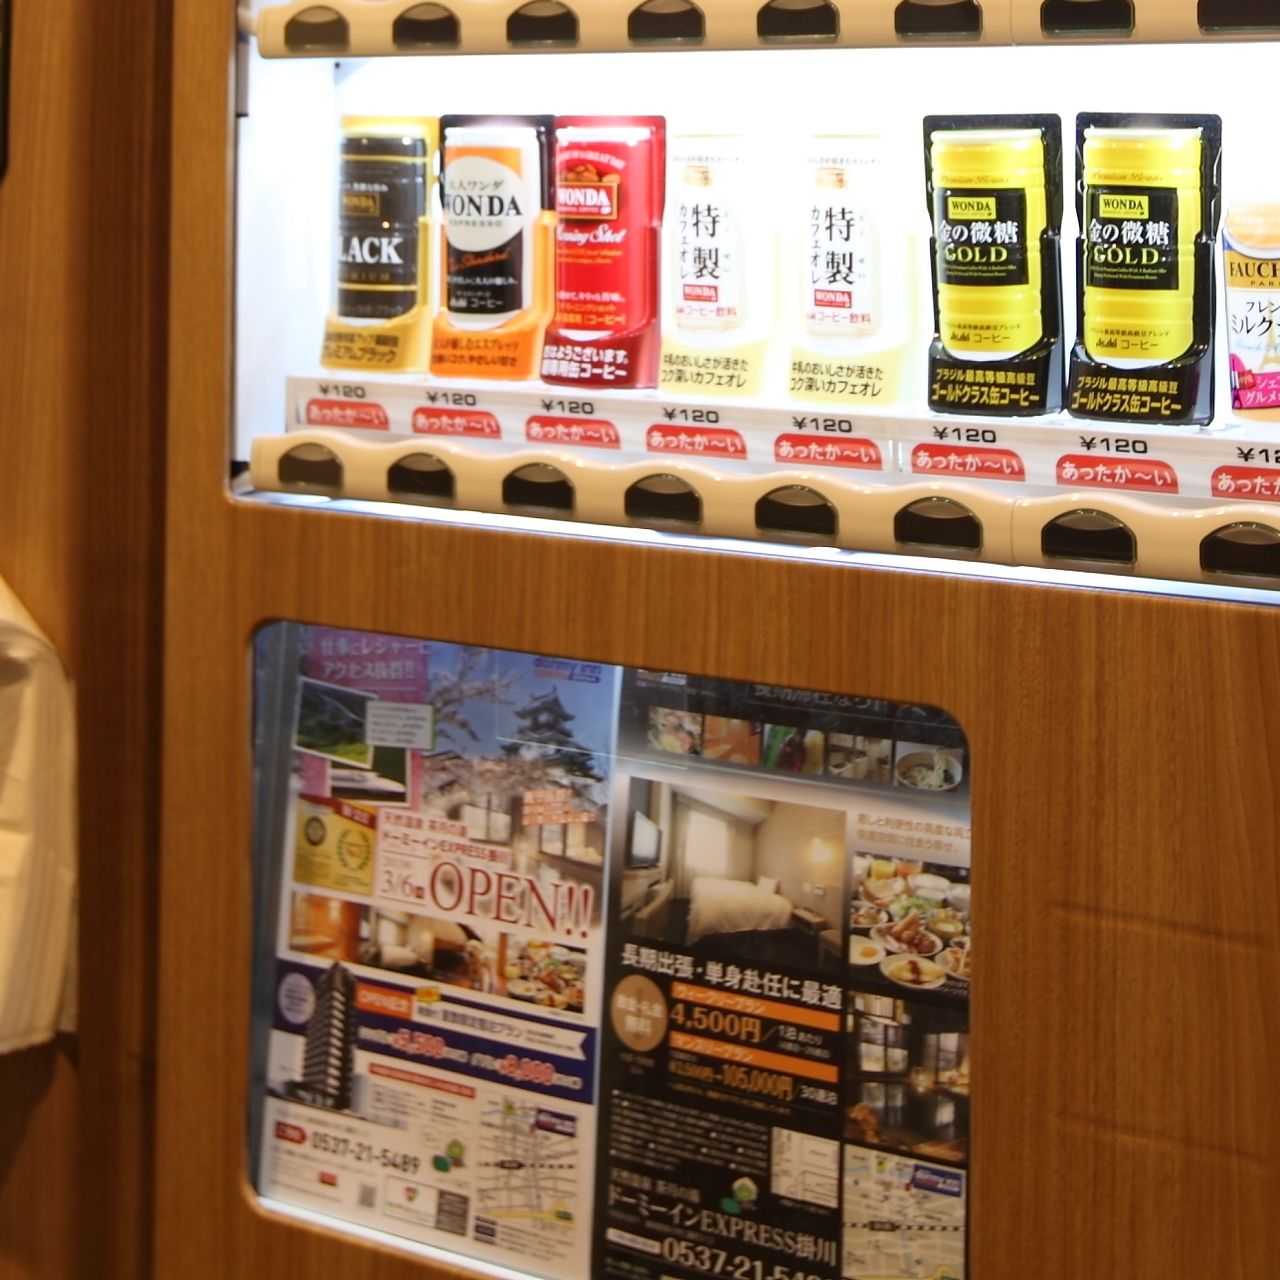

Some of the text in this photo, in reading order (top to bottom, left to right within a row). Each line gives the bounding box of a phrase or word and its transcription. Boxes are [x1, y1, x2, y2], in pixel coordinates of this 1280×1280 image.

[951, 200, 992, 212] WONDA
[1102, 199, 1144, 212] WONDA
[679, 202, 689, 281] カフェオレ
[691, 204, 721, 280] 特製
[939, 220, 1019, 245] 金の微糖
[1089, 218, 1170, 246] 金の微糖
[811, 205, 821, 285] カフェオレ
[825, 207, 855, 285] 特製
[945, 245, 1008, 265] GOLD
[1093, 244, 1161, 265] GOLD
[319, 383, 366, 399] ¥120
[426, 392, 477, 408] ¥120
[932, 384, 1040, 407] ゴールドクラス缶コーヒー
[541, 399, 595, 415] ¥120
[662, 407, 720, 424] ¥120
[1071, 391, 1182, 416] ゴールドクラス缶コーヒー
[792, 416, 852, 433] ¥120
[932, 426, 997, 443] ¥120
[1080, 435, 1148, 454] ¥120
[430, 861, 594, 939] OPEN!!
[621, 943, 844, 1010] 長期出張・単身赴任に最適
[670, 1003, 763, 1043] 4,500円
[311, 1130, 421, 1174] 0537-21-5489
[608, 1184, 838, 1267] ドーミーインEXPRESS掛川
